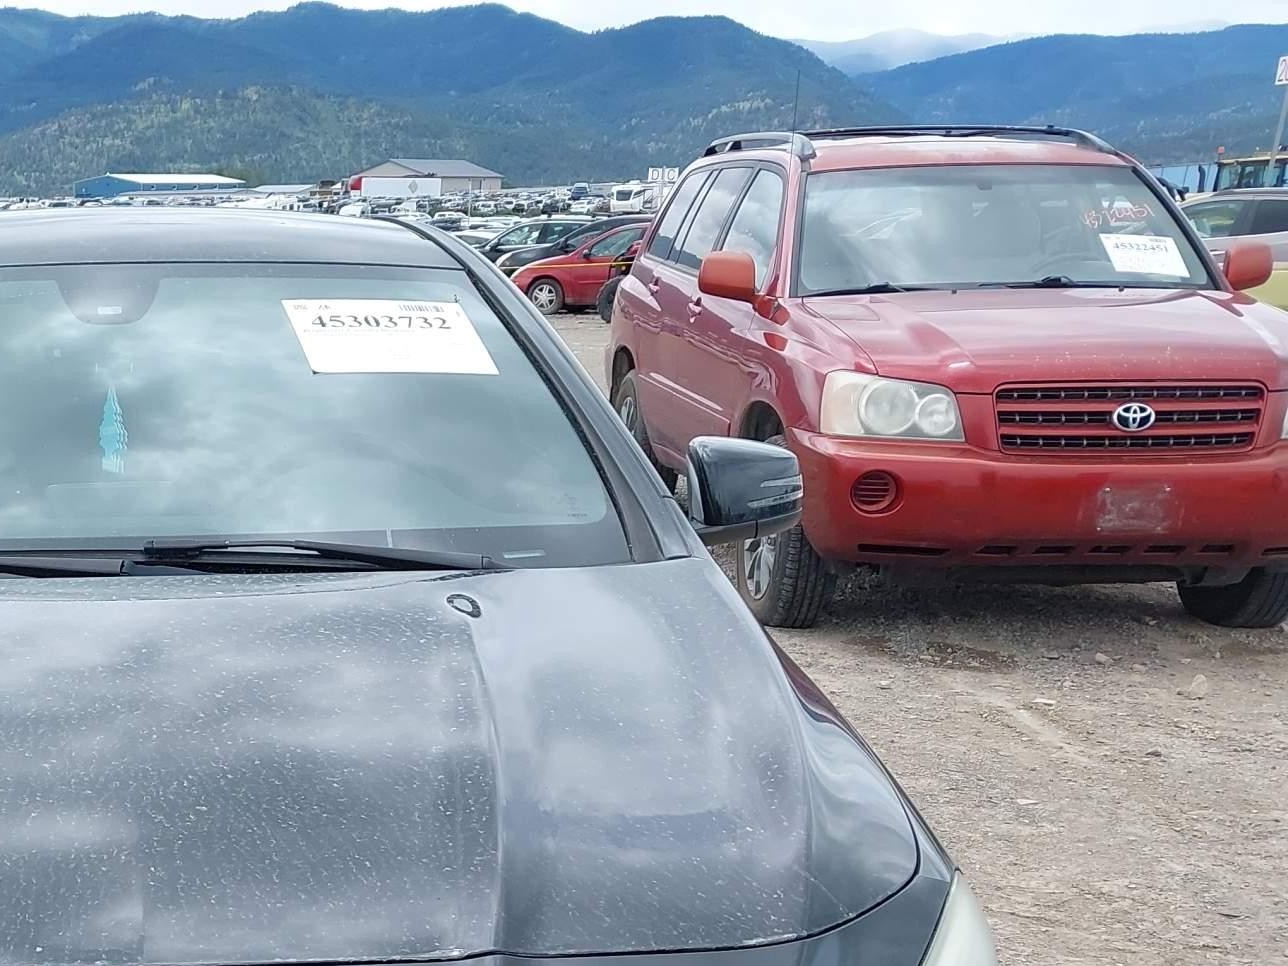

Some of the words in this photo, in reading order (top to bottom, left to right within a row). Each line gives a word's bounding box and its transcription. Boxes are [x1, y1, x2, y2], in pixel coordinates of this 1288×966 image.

[652, 169, 660, 180] D
[667, 169, 675, 180] C
[311, 314, 452, 330] 45303732
